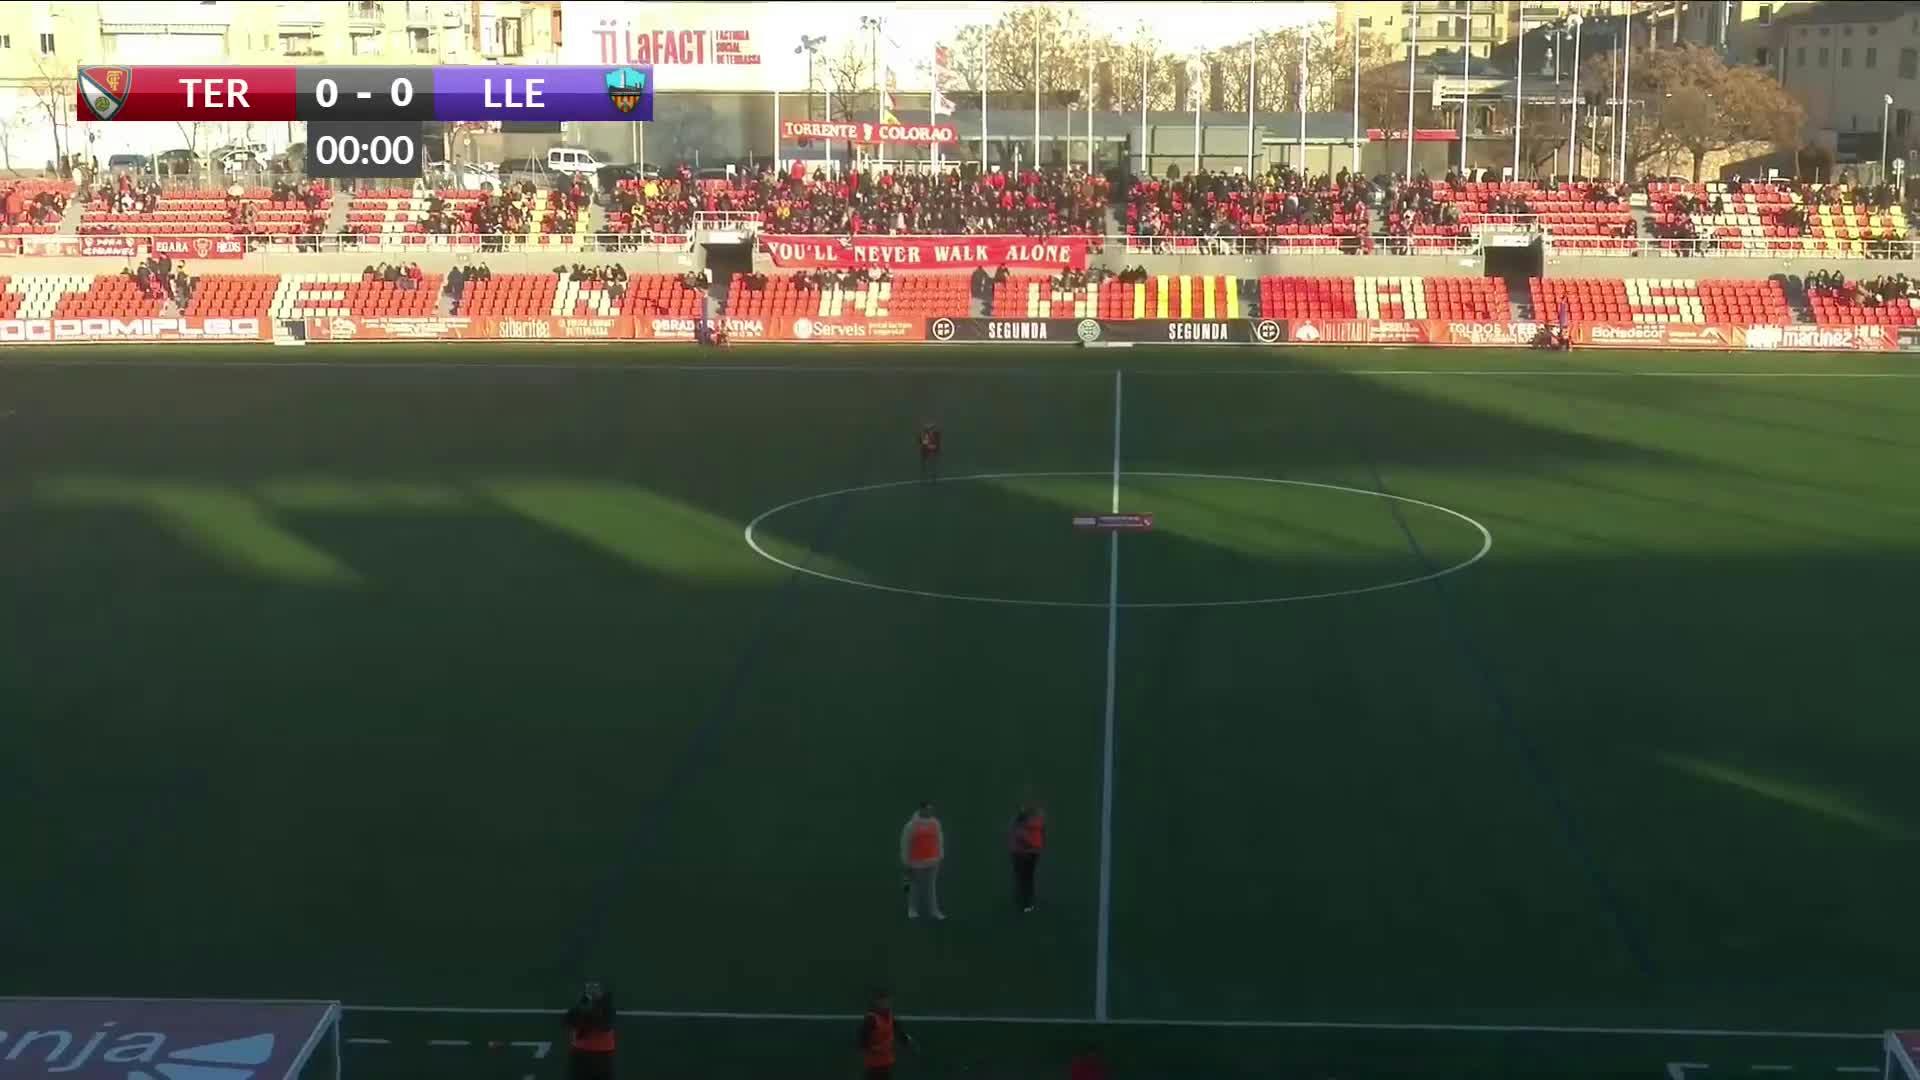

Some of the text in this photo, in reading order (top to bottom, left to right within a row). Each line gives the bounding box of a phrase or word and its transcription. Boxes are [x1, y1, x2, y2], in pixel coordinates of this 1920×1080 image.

[785, 122, 952, 140] TORRENTE COLORAO
[767, 241, 1071, 262] YOU'LL NEVER WALK ALONE
[813, 321, 865, 336] Serveis
[988, 322, 1047, 339] SEGUNDA
[1168, 322, 1228, 339] SEGUNDA
[0, 1021, 166, 1073] nja
